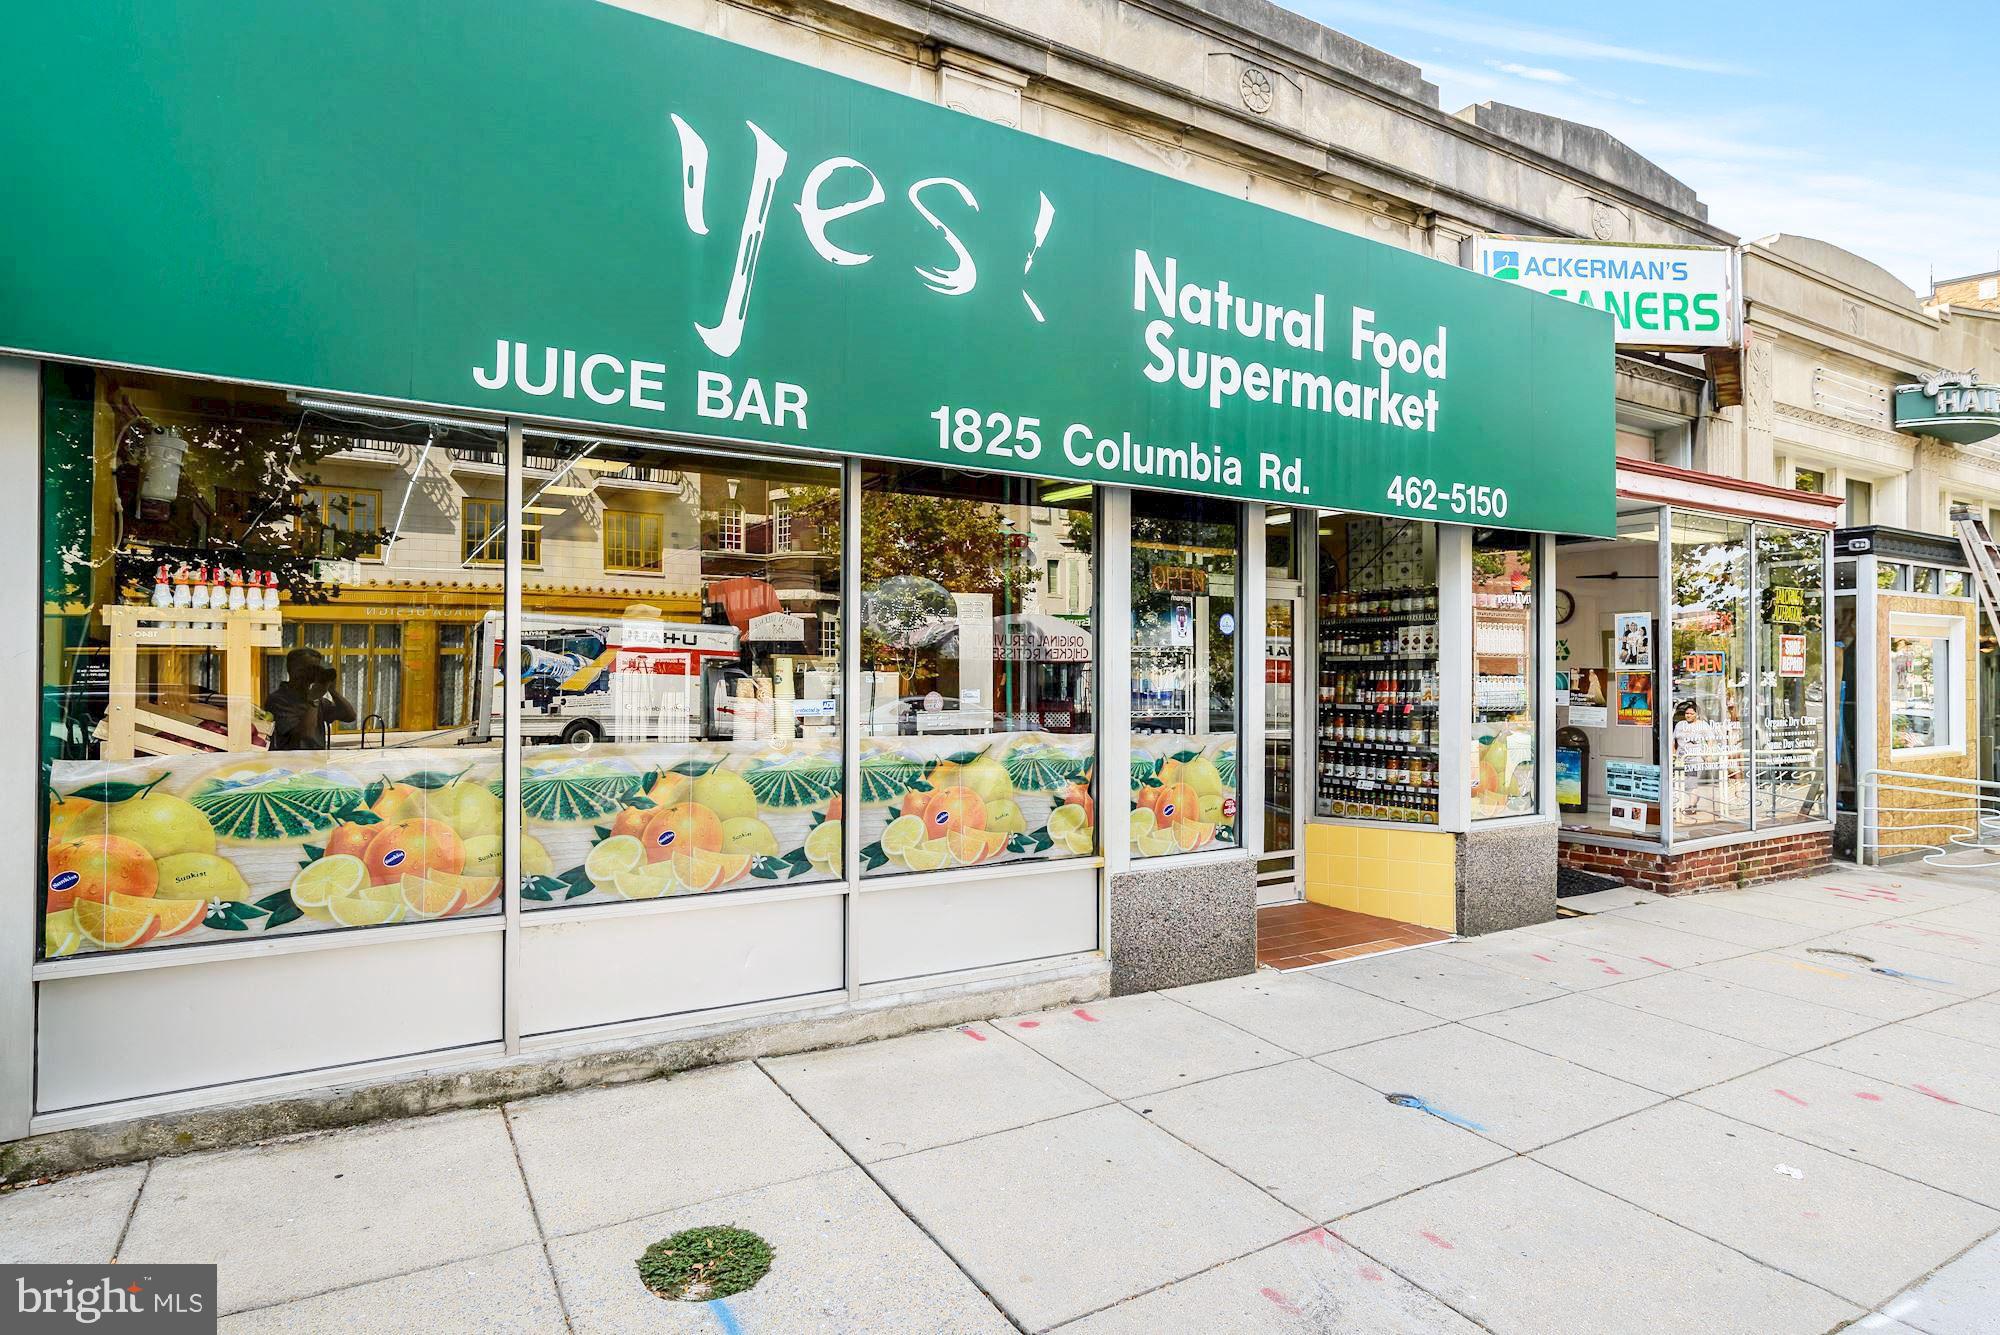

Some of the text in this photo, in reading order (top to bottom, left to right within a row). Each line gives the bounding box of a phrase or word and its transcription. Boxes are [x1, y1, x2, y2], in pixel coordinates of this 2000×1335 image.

[1524, 256, 1688, 281] ACKERMAN'S
[1133, 248, 1447, 380] Natural Food
[1547, 289, 1720, 332] NERS
[472, 337, 809, 430] JUICE BAR
[1142, 319, 1439, 433] Supermarket
[930, 405, 1311, 495] 1825 Columbia Rd.
[1387, 475, 1508, 519] 462-5150
[1152, 566, 1206, 592] OPEN
[1685, 654, 1722, 673] OPEN
[478, 850, 503, 863] Sunkist
[51, 873, 78, 889] Sunkist
[175, 871, 208, 884] Sunkist
